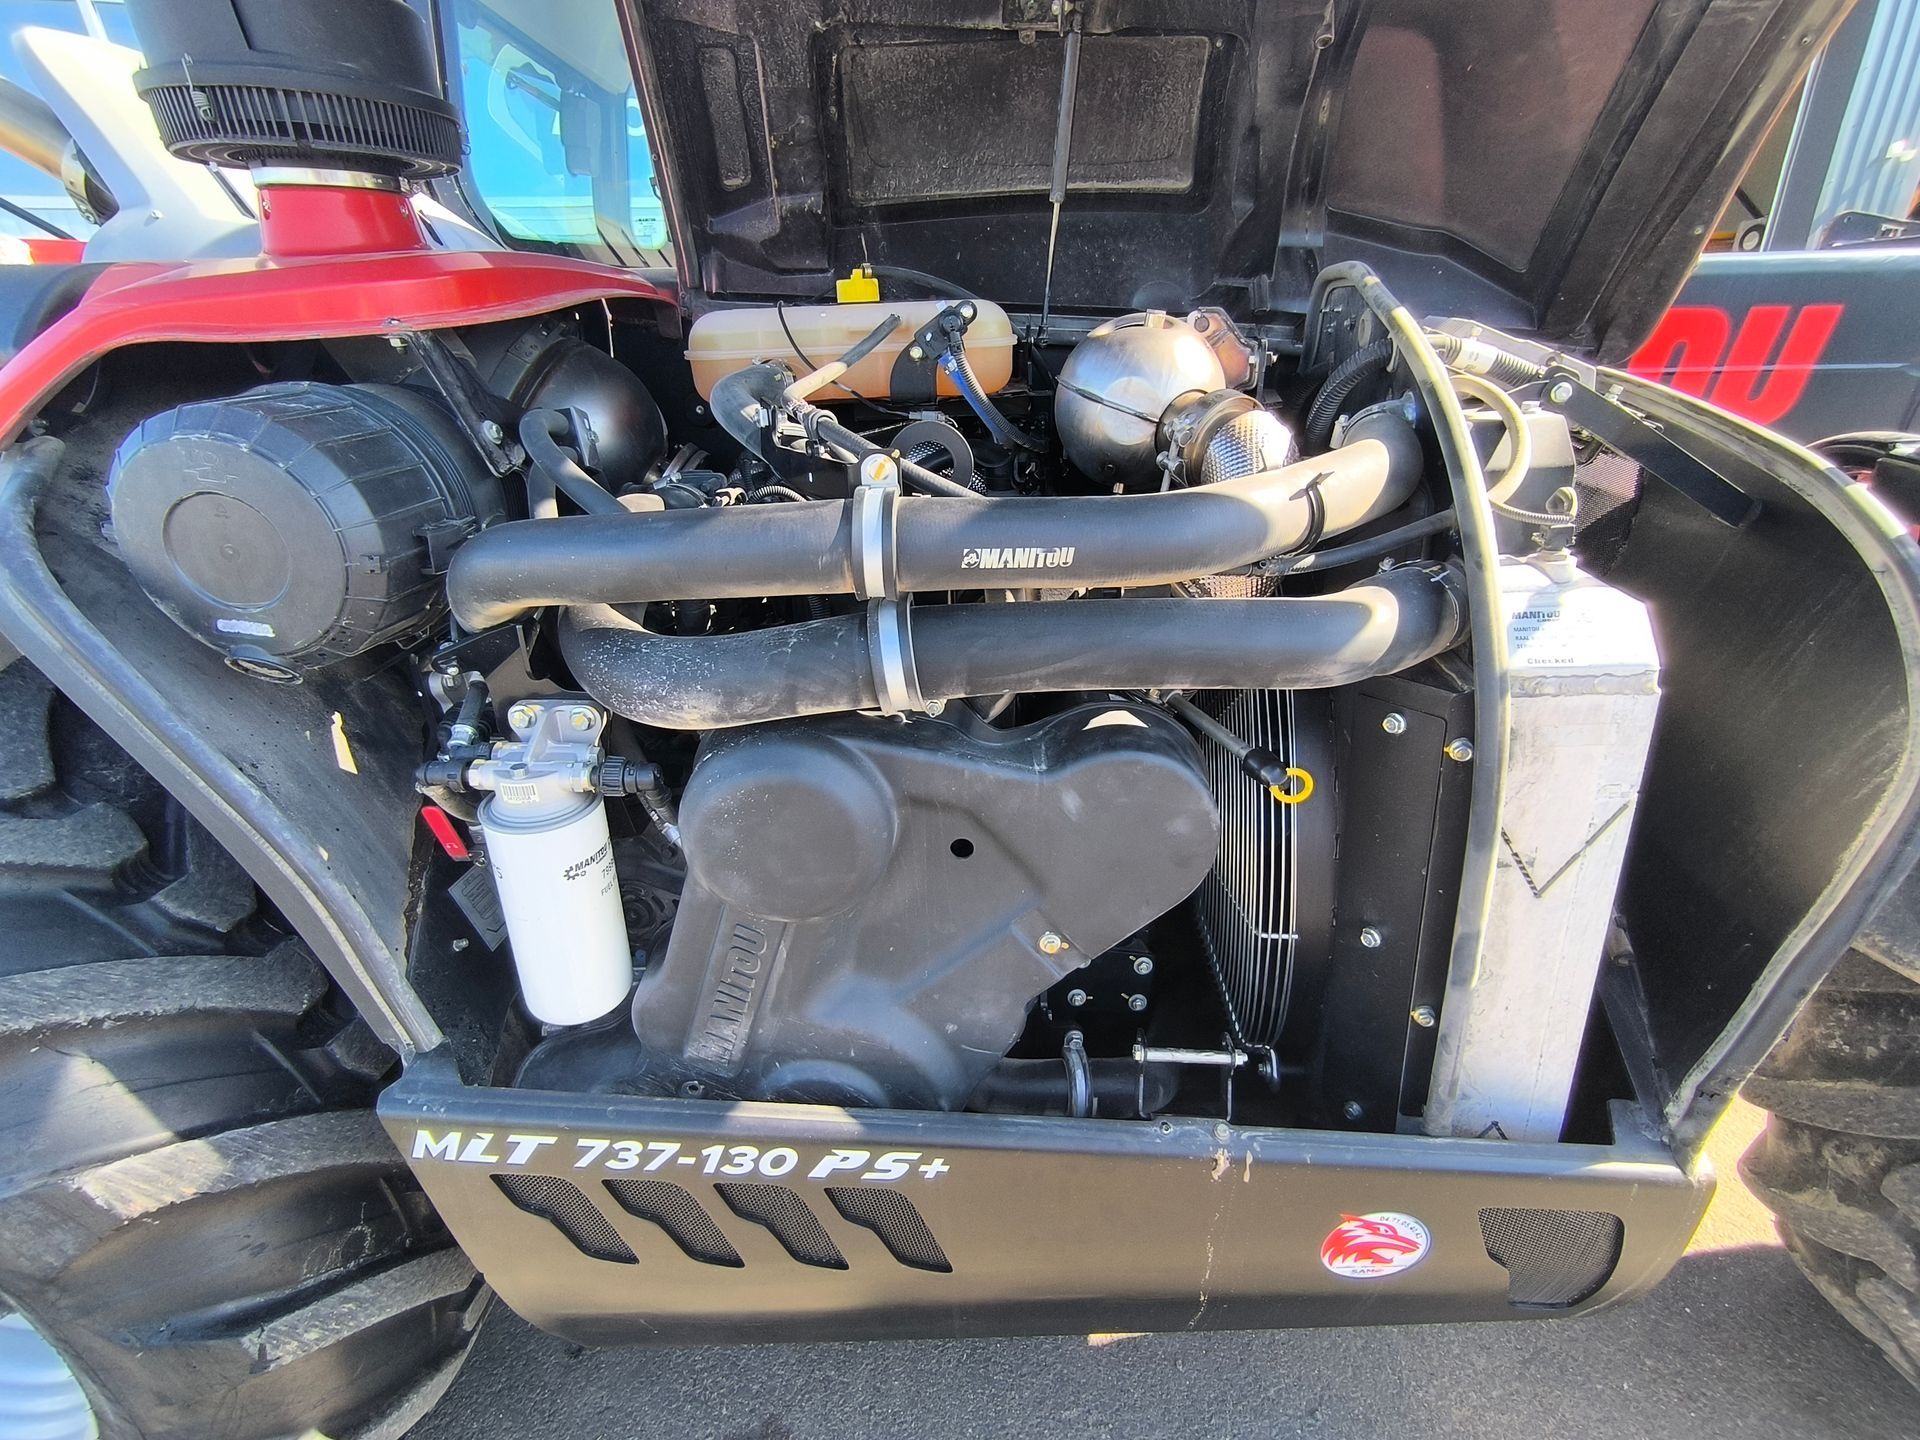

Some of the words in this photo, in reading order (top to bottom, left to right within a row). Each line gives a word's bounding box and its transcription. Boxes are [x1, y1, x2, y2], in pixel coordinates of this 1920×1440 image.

[979, 546, 1076, 569] MANITOU
[411, 1129, 559, 1165] MLT
[573, 1138, 799, 1177] 737-130
[807, 1148, 951, 1180] PS+
